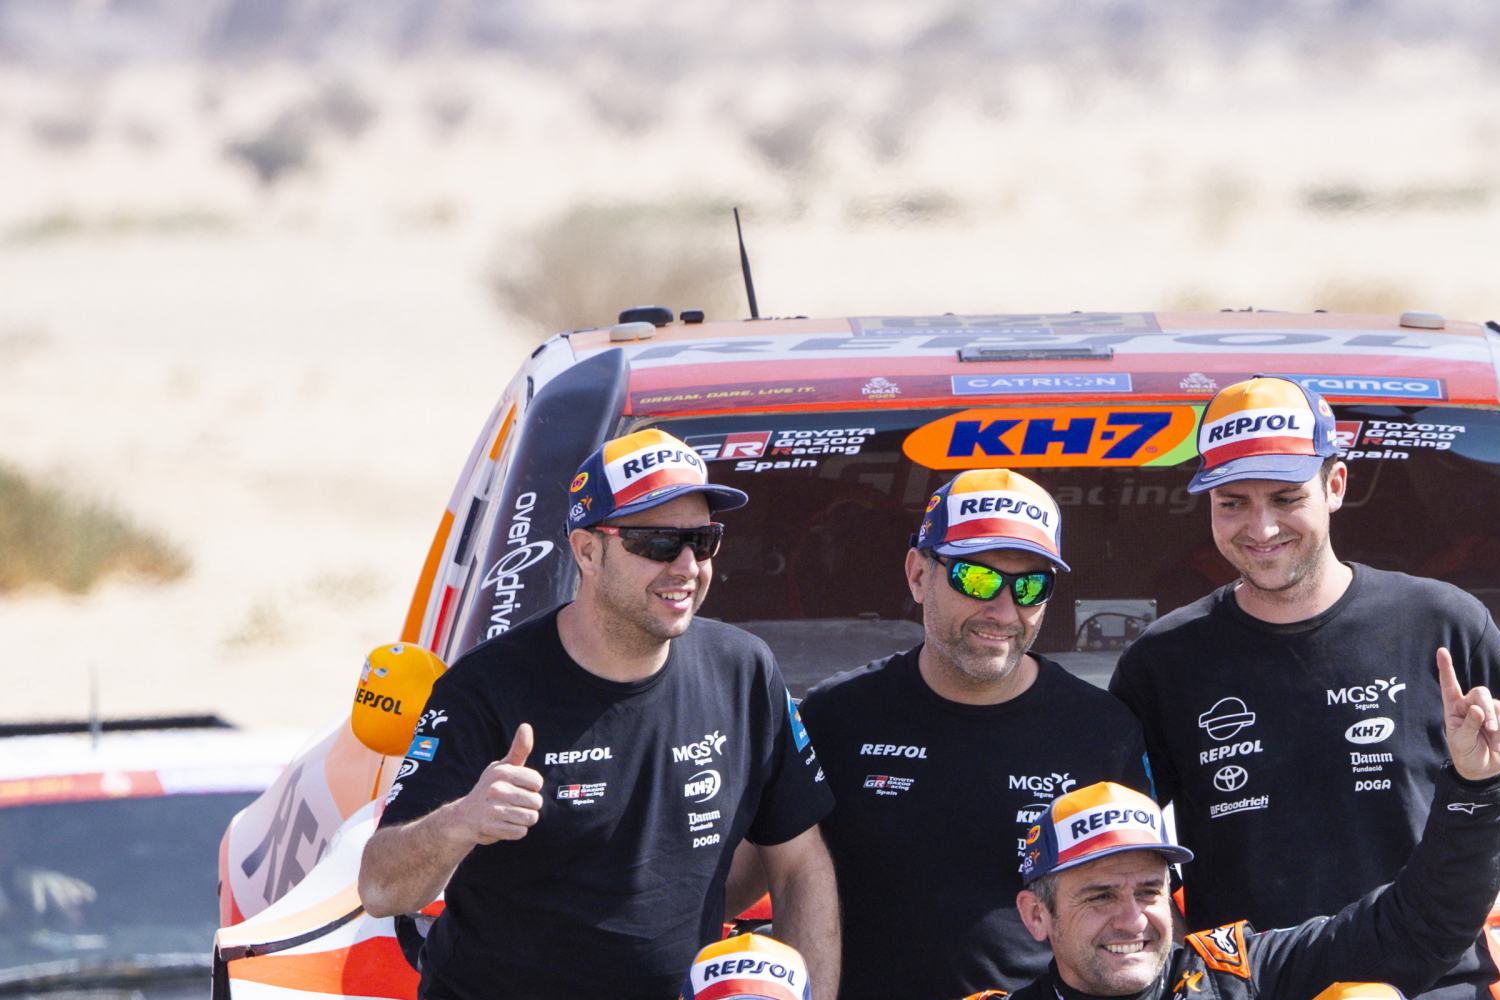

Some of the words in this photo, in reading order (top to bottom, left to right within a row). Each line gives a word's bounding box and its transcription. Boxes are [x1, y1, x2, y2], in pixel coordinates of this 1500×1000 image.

[861, 386, 901, 395] DAKAR
[1300, 377, 1430, 393] ramco
[777, 428, 876, 438] TOYOTA
[1208, 414, 1300, 443] REPSOL
[1367, 420, 1466, 433] TOYOTA
[774, 437, 866, 447] GAZOO
[1364, 429, 1456, 440] GAZOO
[771, 445, 861, 456] Racing
[1362, 437, 1452, 450] Racing
[623, 449, 704, 479] REPSOL
[735, 459, 818, 472] Spain
[960, 497, 1050, 527] REPSOL
[355, 688, 402, 715] EPSOL
[1327, 685, 1378, 705] MGS
[545, 747, 613, 765] REPSOL
[672, 741, 712, 762] MGS
[860, 744, 927, 758] REPSOL
[1199, 740, 1264, 765] REPSOL
[1350, 752, 1393, 765] Damm
[1352, 765, 1383, 773] Fundació
[1009, 775, 1053, 791] MGS
[1355, 779, 1391, 791] DOGA
[1210, 795, 1269, 815] BFGoodrich
[688, 810, 720, 825] Damm
[1071, 809, 1156, 839] REPSOL
[693, 834, 720, 848] DOGA
[704, 959, 795, 986] REPSOL
